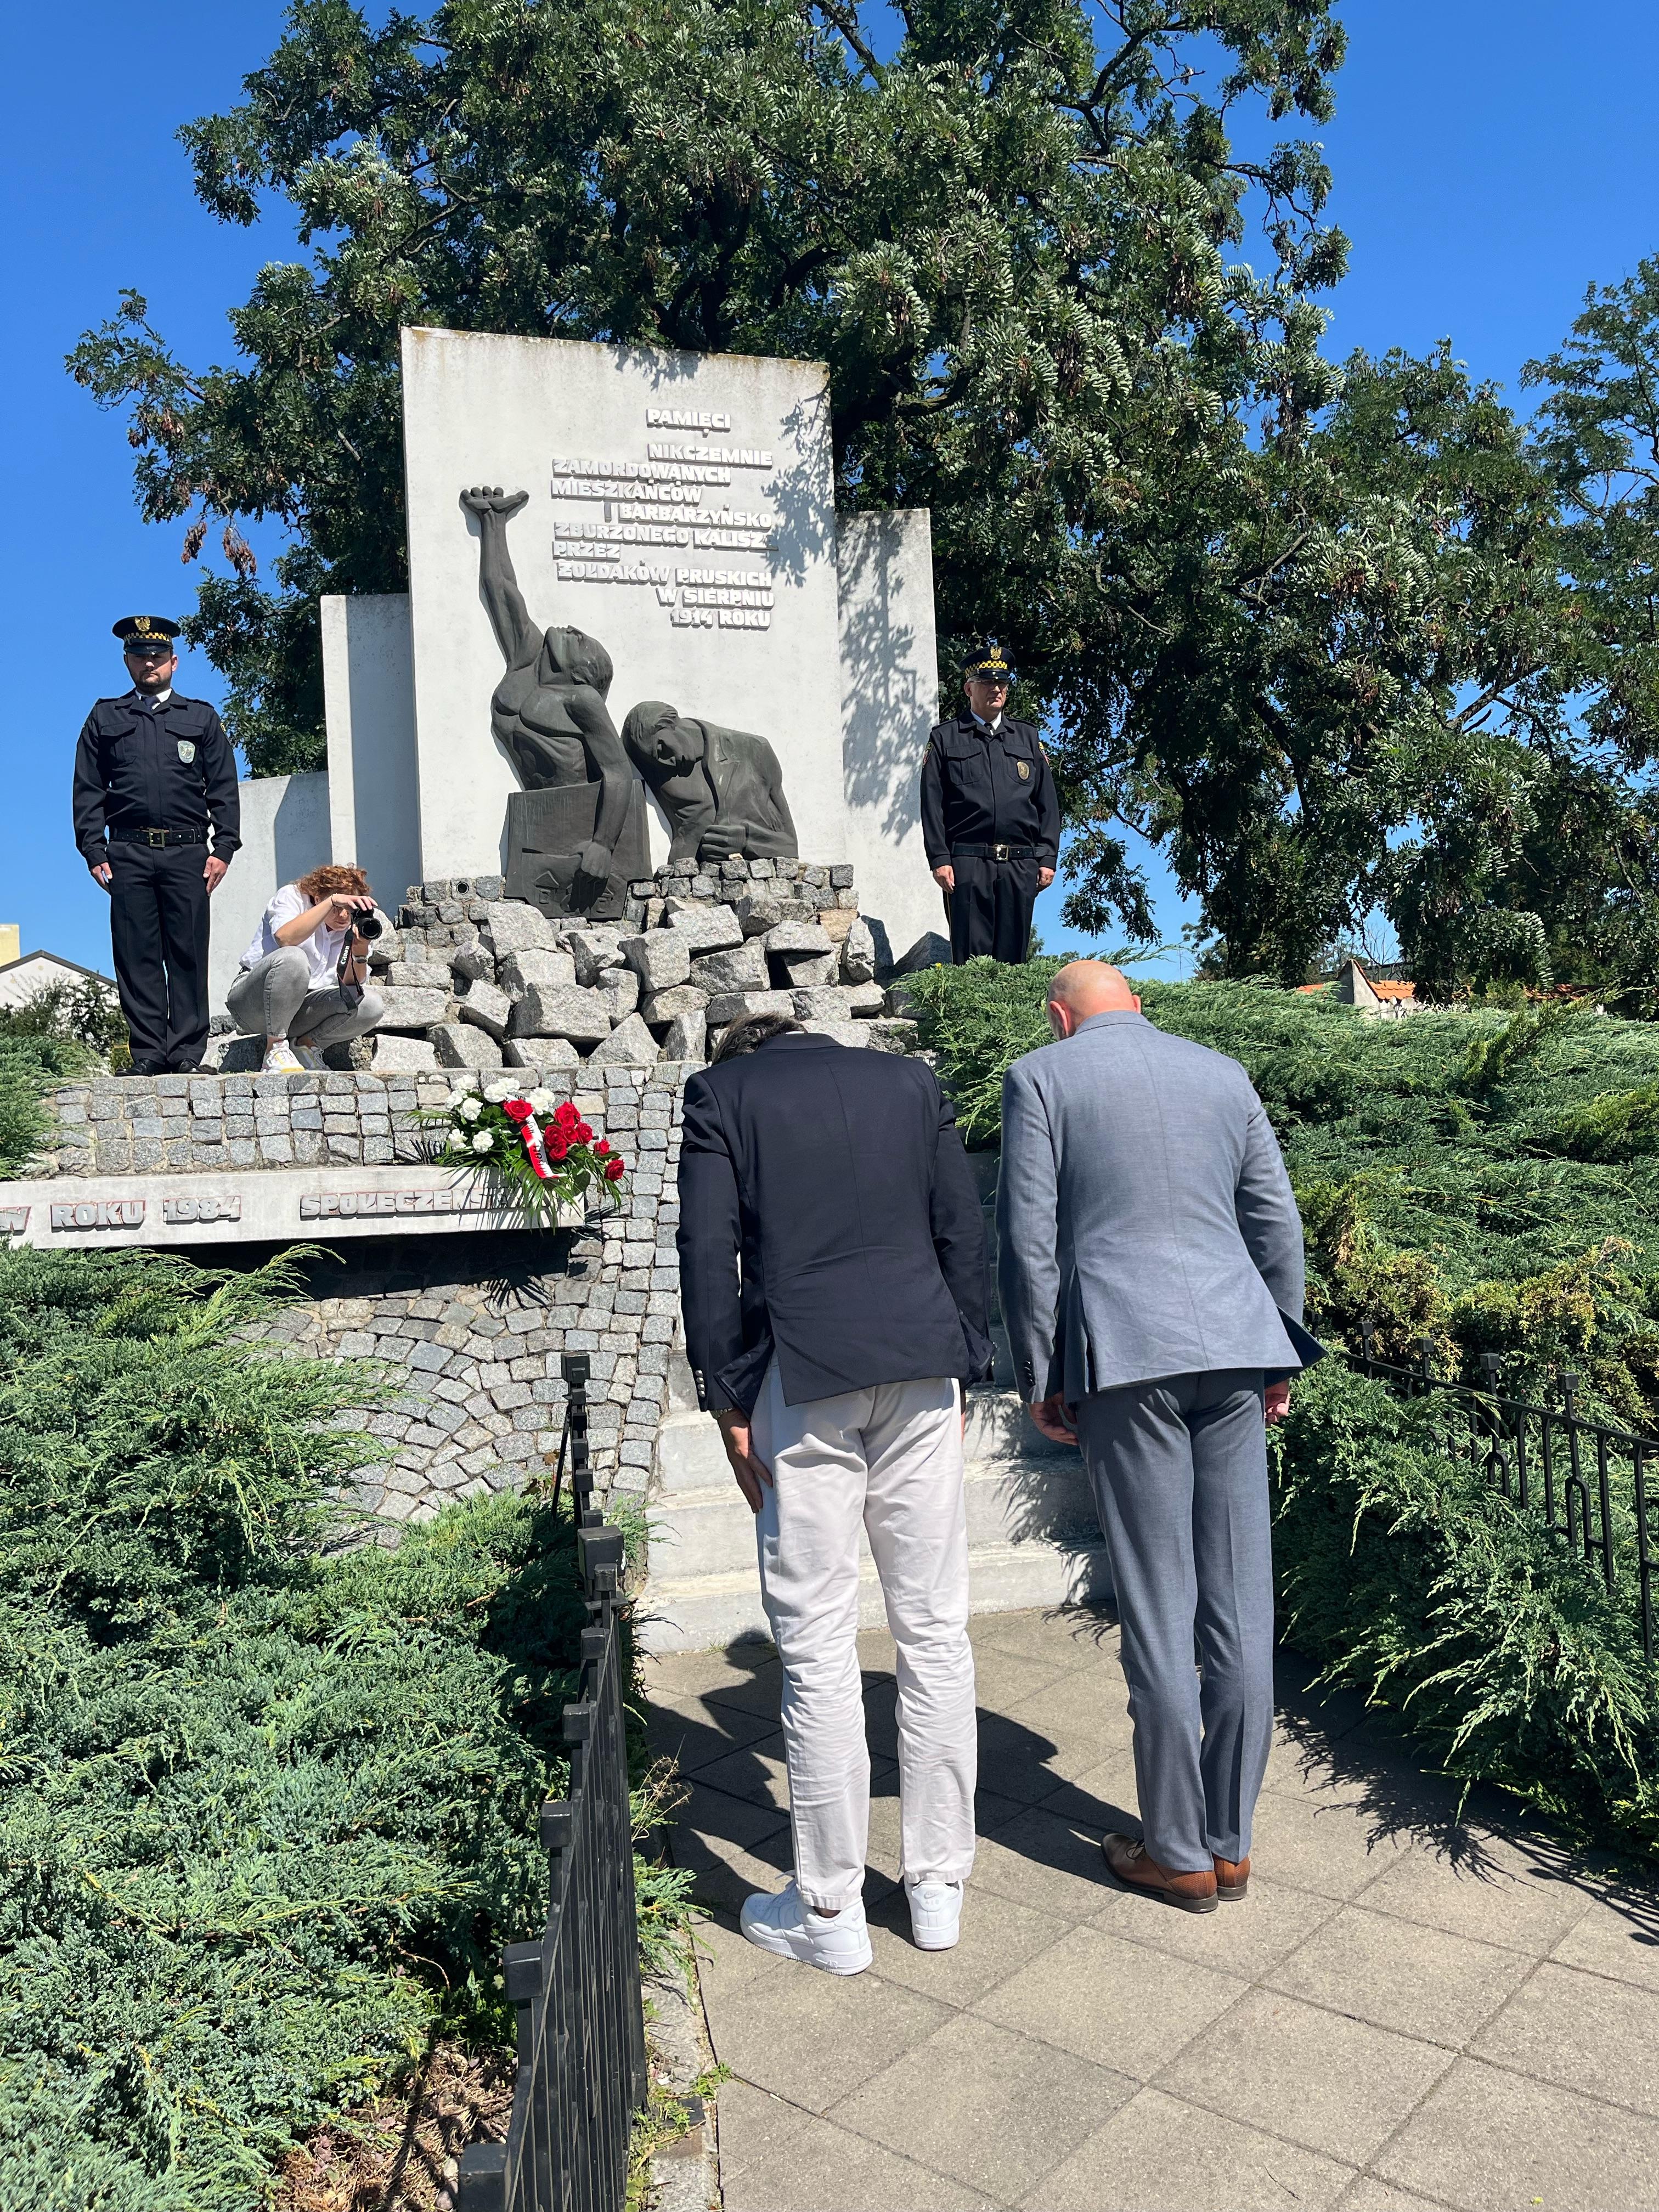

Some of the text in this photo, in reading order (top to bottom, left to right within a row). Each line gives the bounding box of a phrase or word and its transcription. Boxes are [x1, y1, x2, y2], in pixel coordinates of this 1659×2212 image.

[646, 409, 731, 438] PAMIĘCI
[647, 444, 772, 470] NIKCZEMNIE
[552, 459, 731, 486] ZAMORDOWANYCH
[551, 479, 702, 507] MIESZKAŃCÓW
[604, 502, 772, 531] I BARBARZYŃSKO
[554, 522, 689, 548] ZBURZONEGO
[552, 541, 620, 562] PRZEZ
[675, 568, 772, 590] PRUSKICH
[656, 588, 774, 611] W SIERPNIU
[670, 610, 770, 631] 1914 ROKU
[340, 945, 350, 965] Canon
[50, 1200, 145, 1232] ROKU
[163, 1195, 241, 1224] 1984
